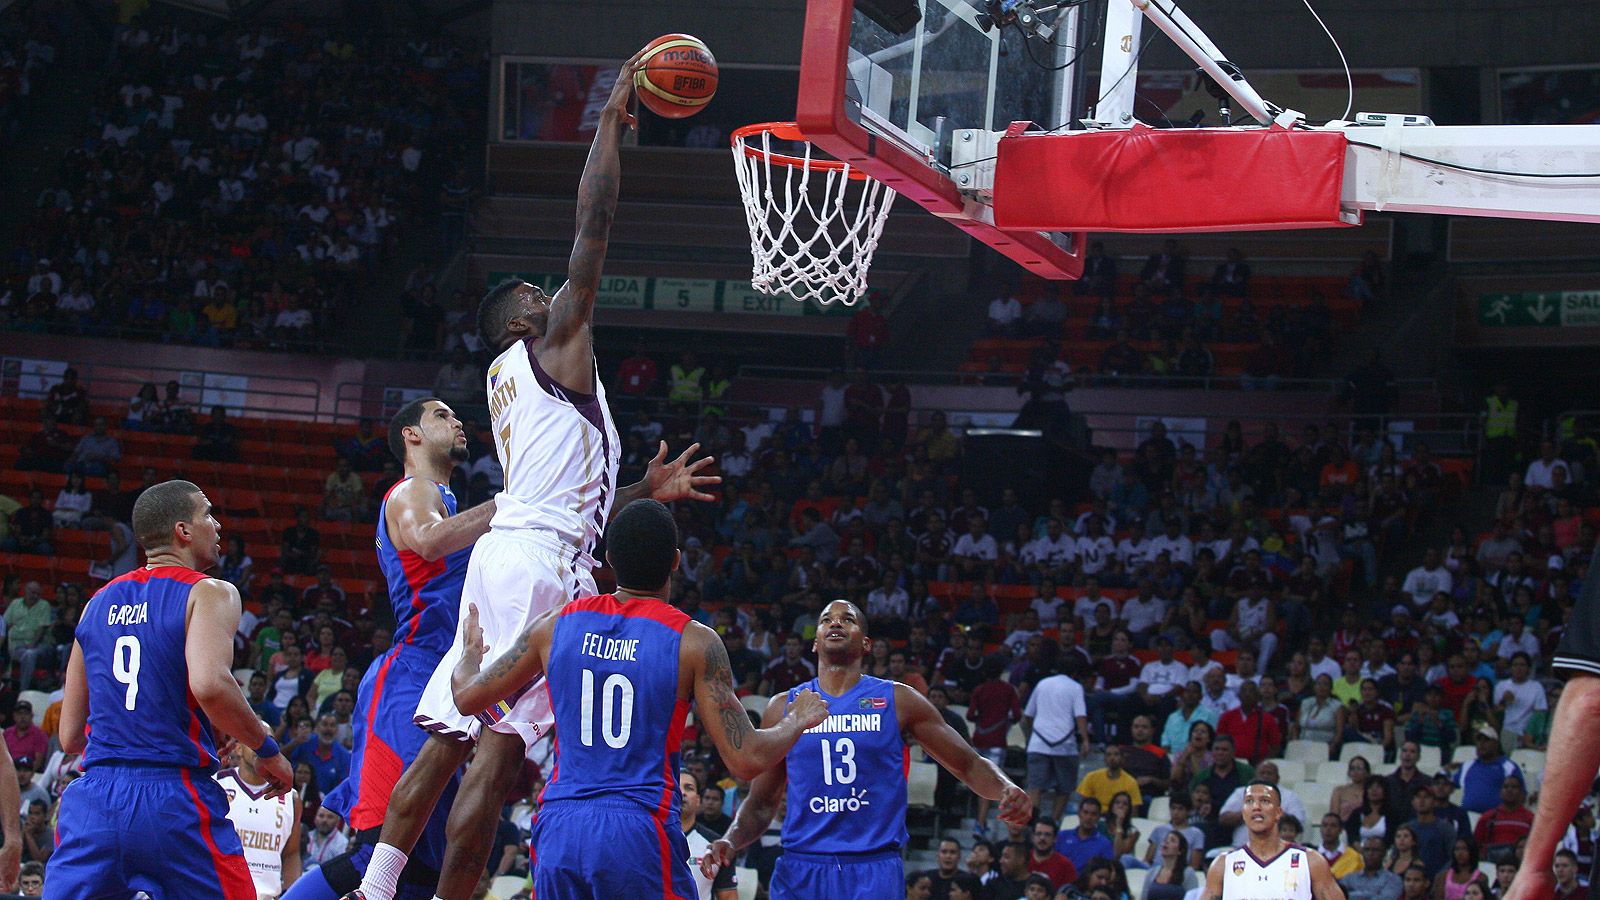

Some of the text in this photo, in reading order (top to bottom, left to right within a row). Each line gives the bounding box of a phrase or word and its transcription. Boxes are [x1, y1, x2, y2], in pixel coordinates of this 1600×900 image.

[682, 76, 706, 89] FIBA
[598, 279, 639, 292] LIDA
[678, 290, 690, 307] 5
[744, 296, 785, 311] EXIT
[490, 376, 518, 422] MITH
[499, 422, 511, 494] 7
[107, 601, 148, 625] GARCIA
[581, 632, 640, 661] FELDEINE
[113, 635, 141, 711] 9
[581, 668, 634, 749] 10
[821, 737, 857, 785] 13
[809, 794, 862, 814] Claro
[275, 806, 284, 829] 5
[236, 828, 281, 851] NEZUELA
